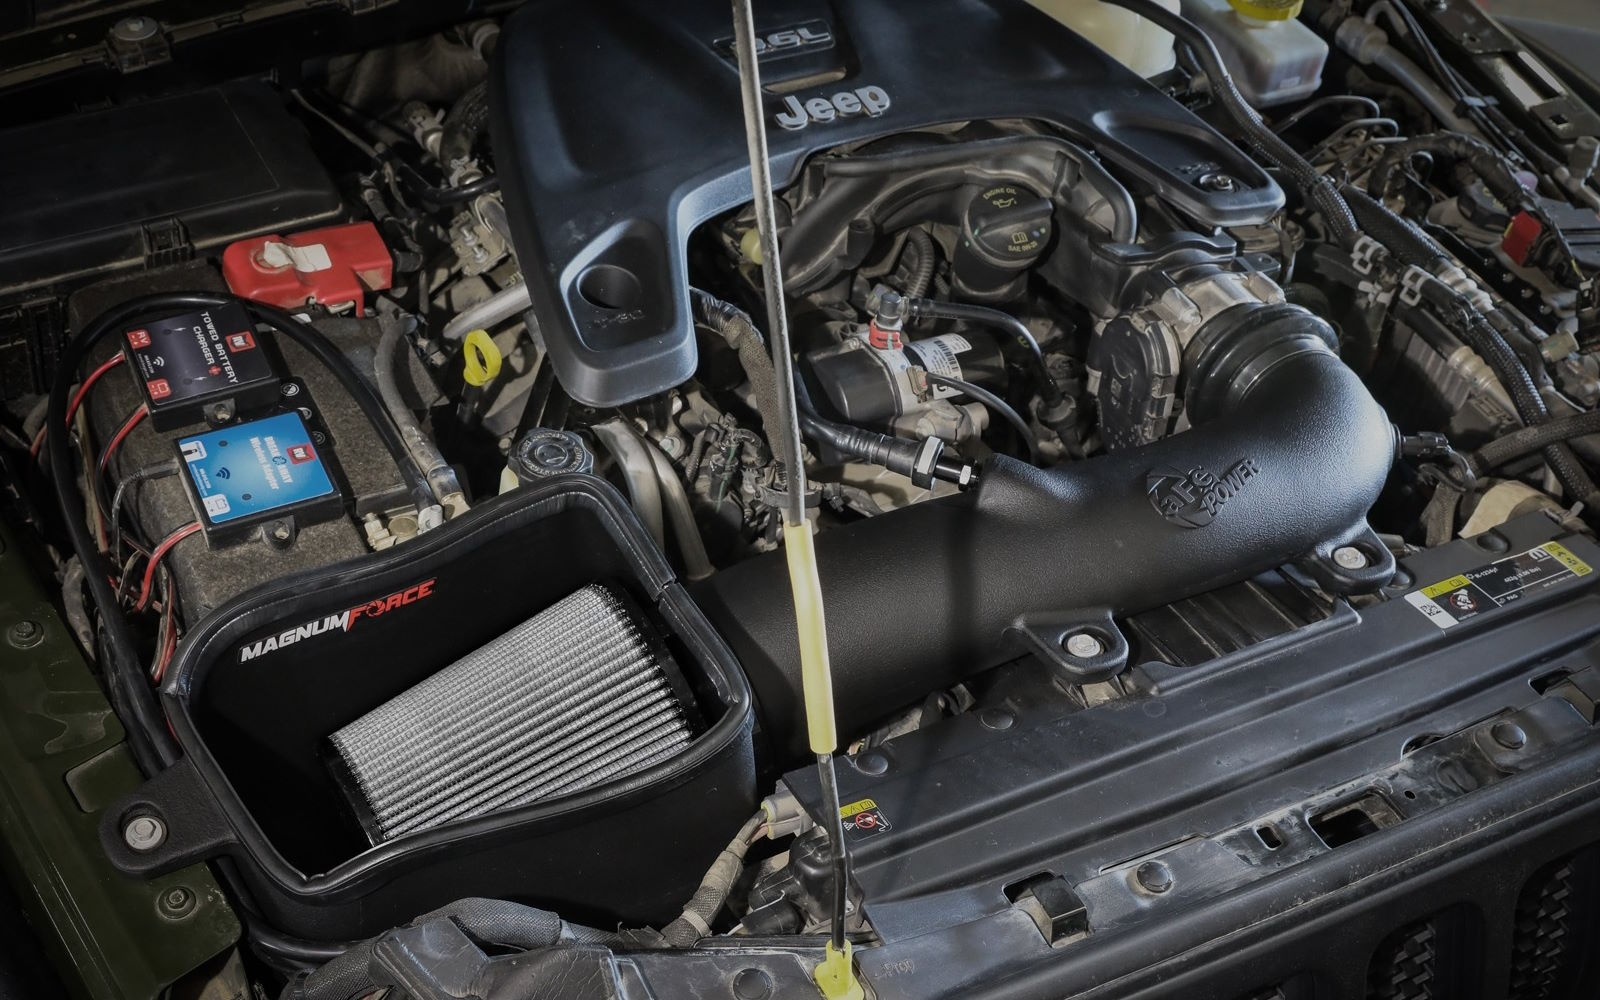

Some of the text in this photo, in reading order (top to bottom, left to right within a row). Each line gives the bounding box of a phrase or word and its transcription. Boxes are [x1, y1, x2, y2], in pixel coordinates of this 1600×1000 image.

[775, 85, 890, 130] Jeep
[1006, 187, 1017, 195] OIL
[136, 330, 149, 344] RV
[192, 325, 215, 365] CHARGER
[200, 311, 239, 384] TOWED BATTERY
[1203, 459, 1259, 517] POWER
